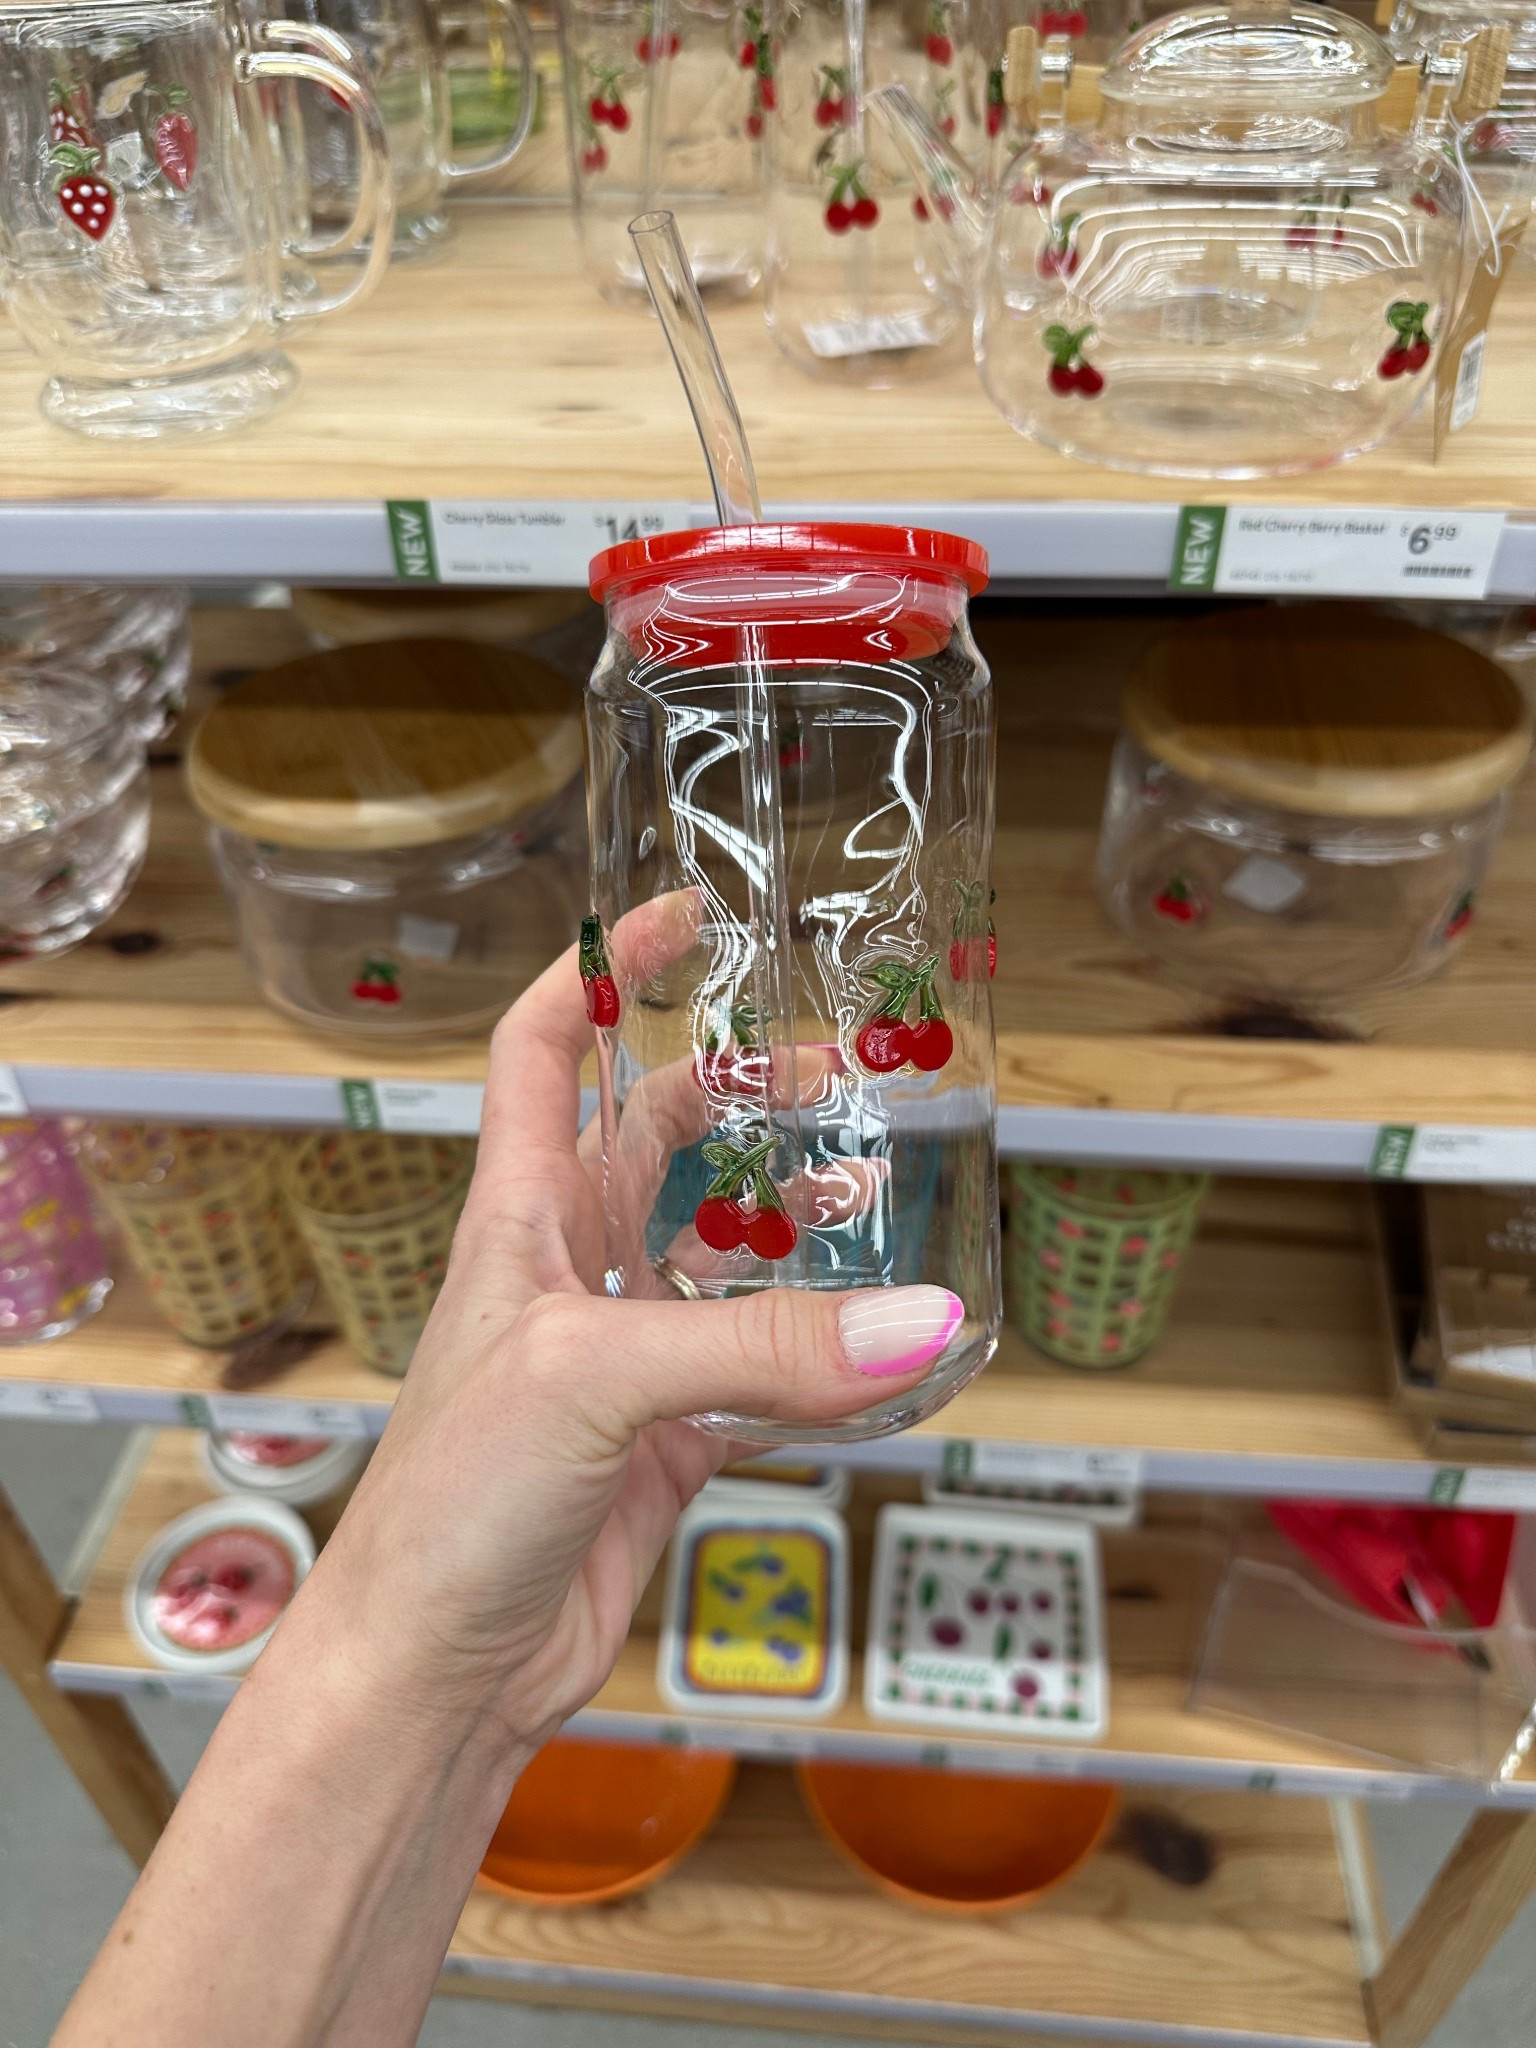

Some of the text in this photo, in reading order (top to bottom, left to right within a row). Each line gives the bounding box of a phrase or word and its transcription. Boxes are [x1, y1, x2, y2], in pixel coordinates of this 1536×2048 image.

[396, 508, 429, 577] NEW
[1181, 517, 1214, 585] NEW
[1265, 516, 1306, 536] Cherry
